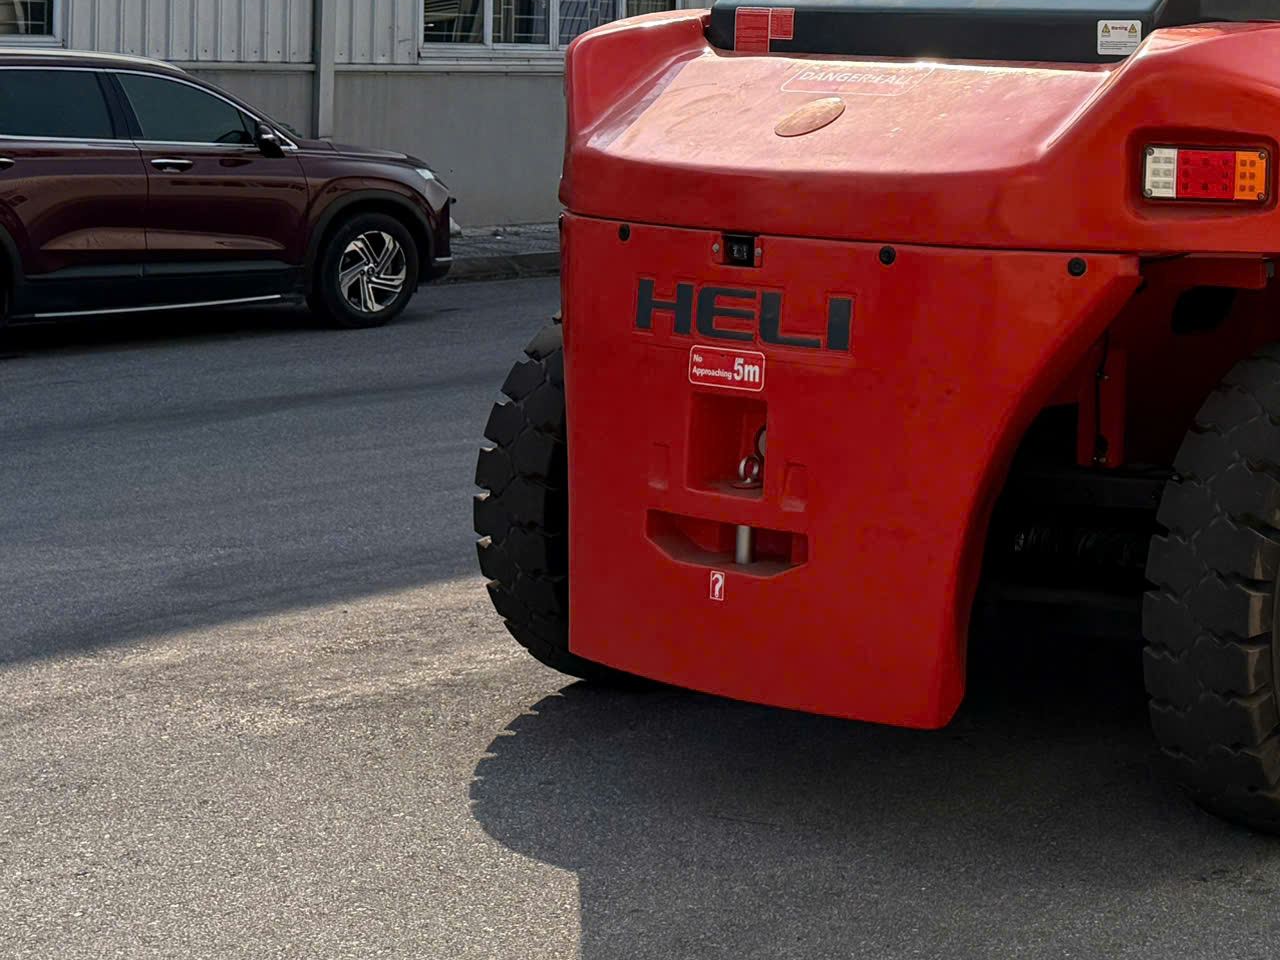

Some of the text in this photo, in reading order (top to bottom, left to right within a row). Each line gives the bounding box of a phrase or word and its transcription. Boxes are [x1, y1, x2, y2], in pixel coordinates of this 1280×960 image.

[635, 278, 853, 352] HELI
[692, 357, 760, 383] Approaching 5m
[693, 353, 703, 363] No
